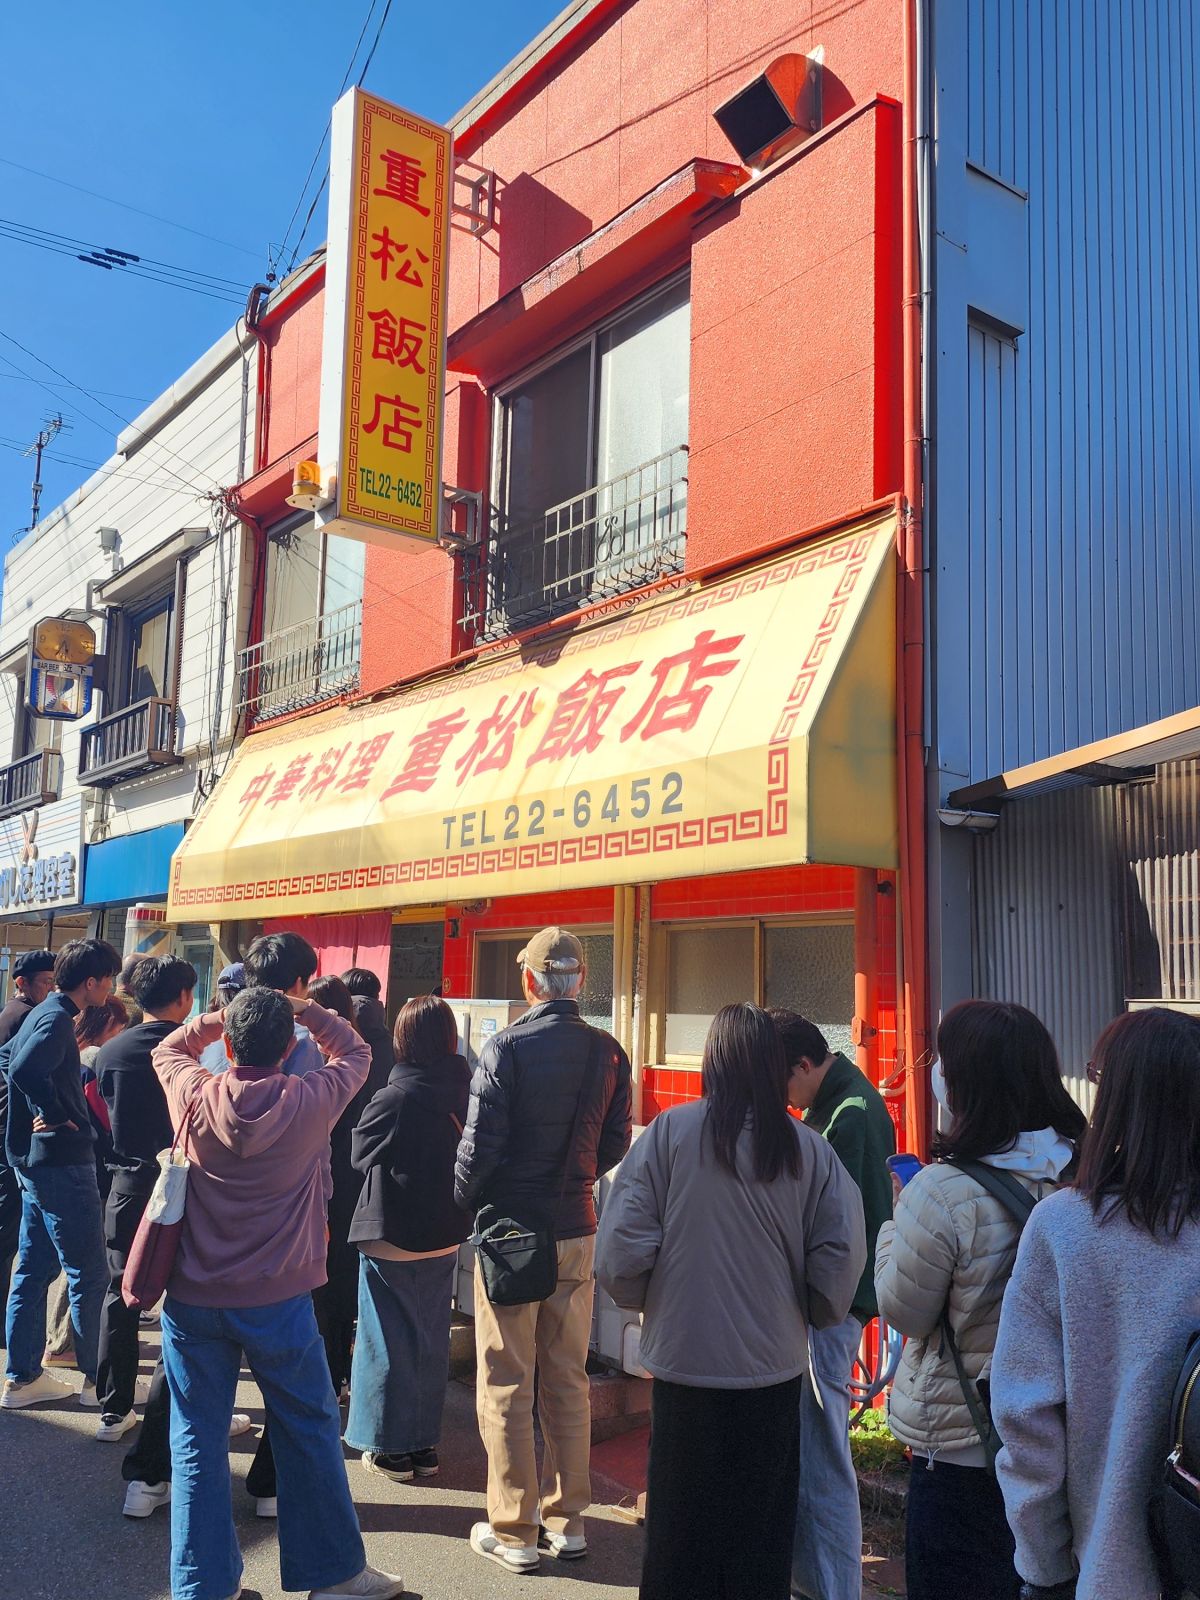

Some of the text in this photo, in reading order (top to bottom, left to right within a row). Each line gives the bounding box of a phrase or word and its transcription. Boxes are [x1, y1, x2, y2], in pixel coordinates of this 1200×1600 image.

[362, 148, 431, 454] 重松飯店
[239, 630, 746, 816] 中華料理 重松飯店
